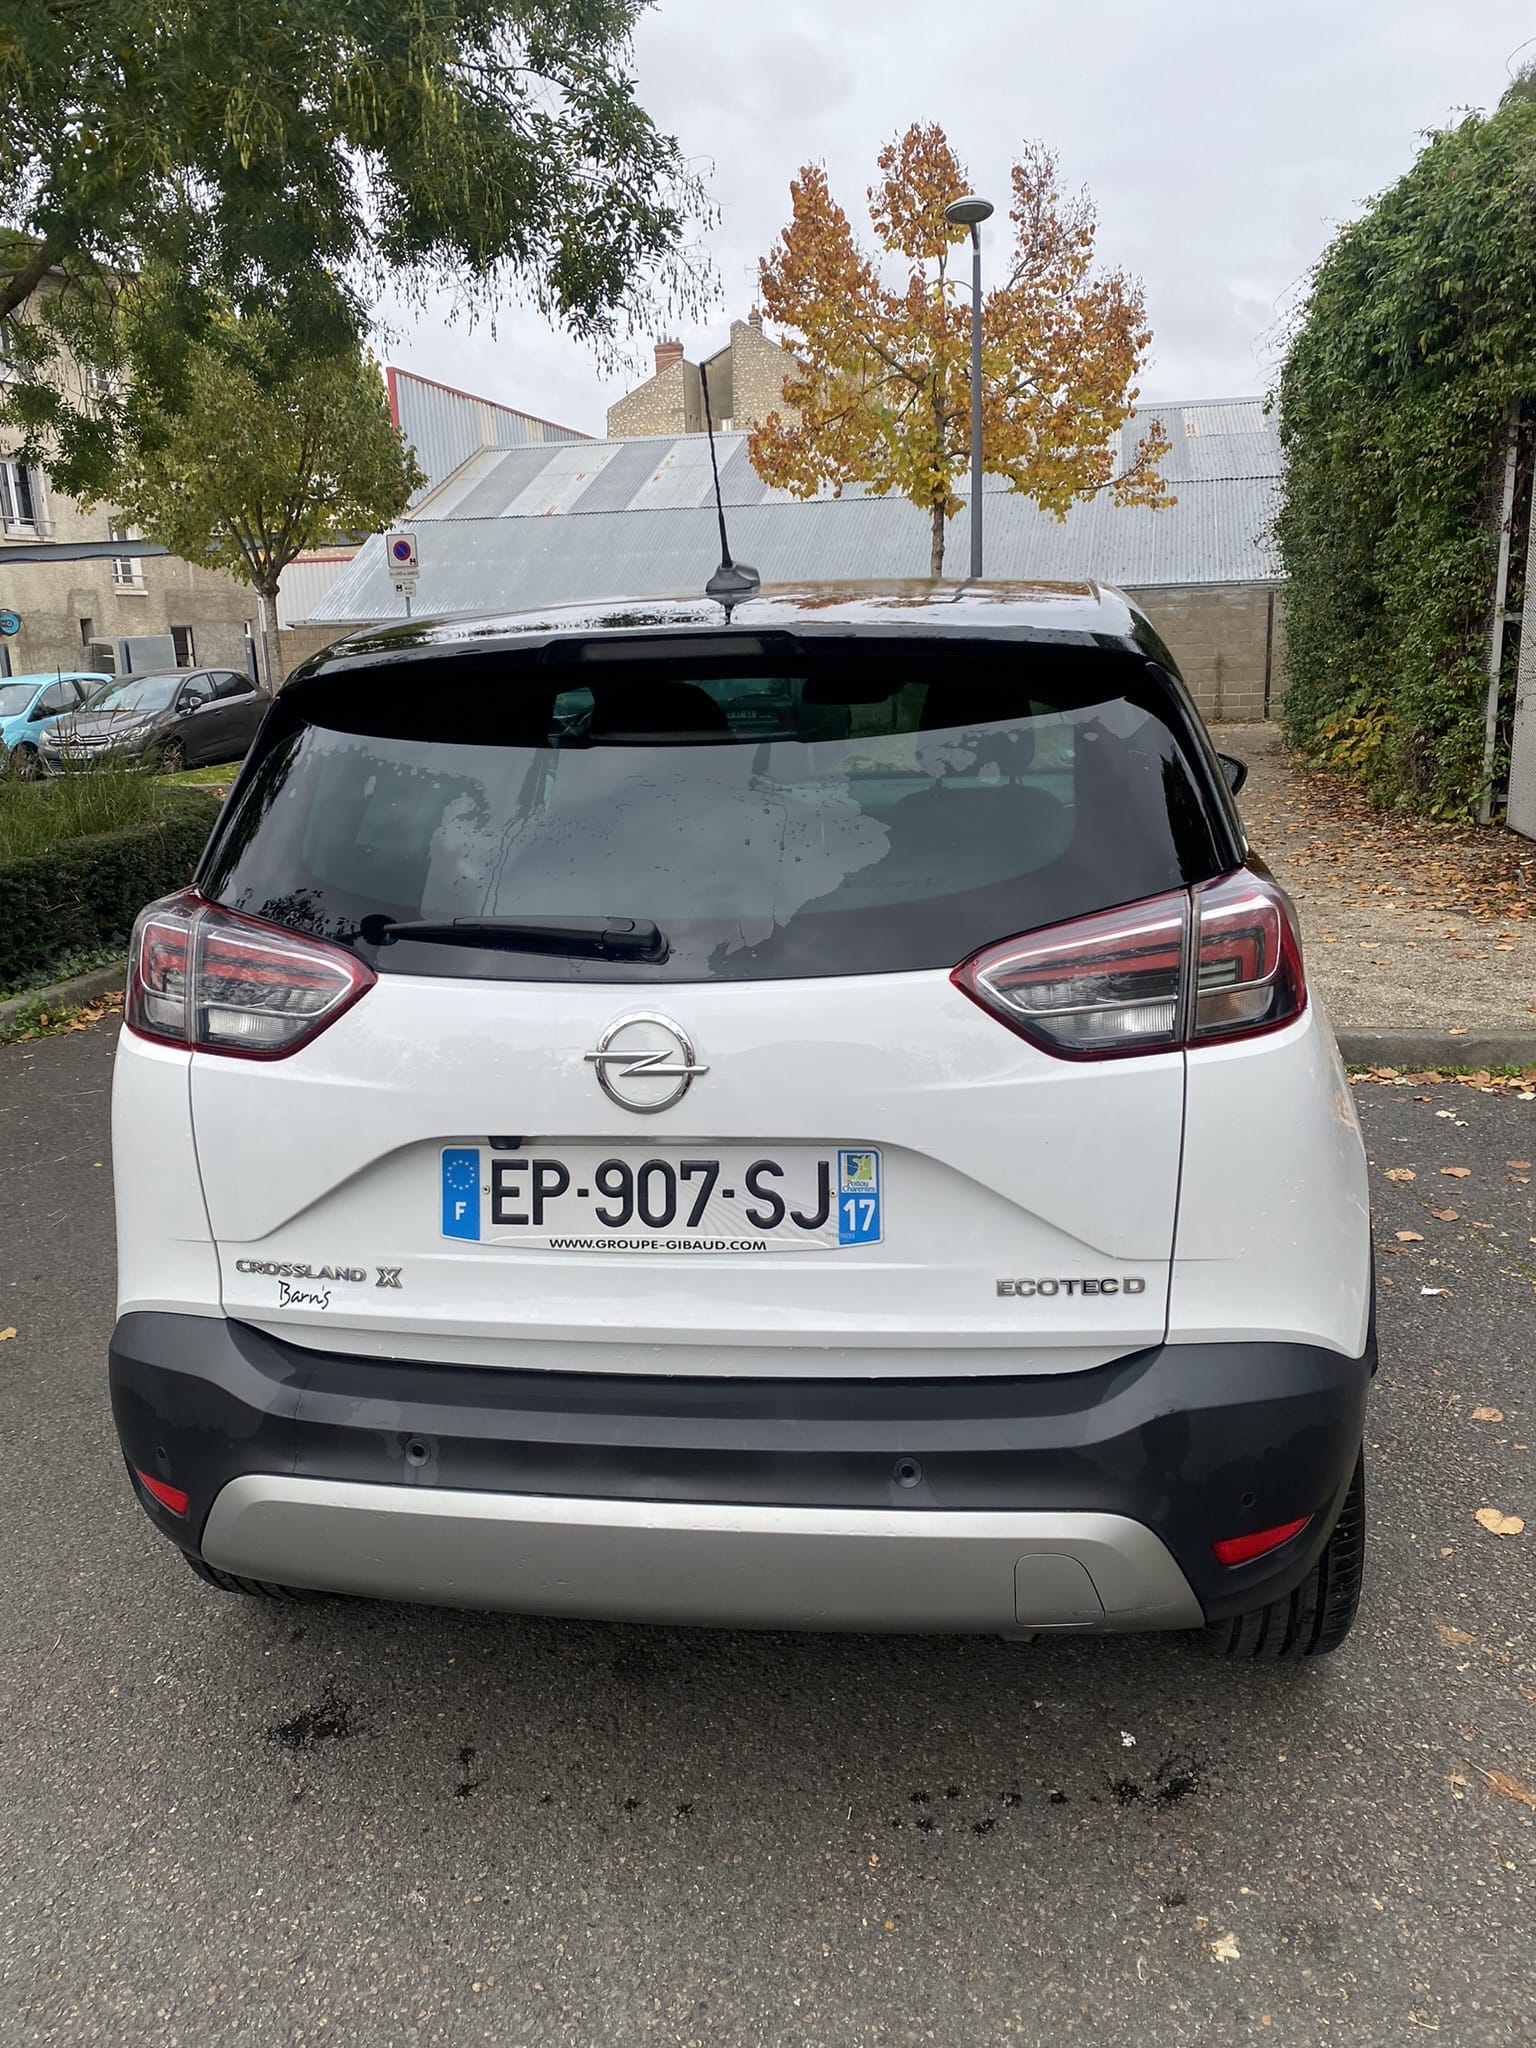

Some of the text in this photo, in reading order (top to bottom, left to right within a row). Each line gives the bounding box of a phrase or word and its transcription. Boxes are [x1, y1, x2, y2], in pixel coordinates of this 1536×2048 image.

[491, 1158, 829, 1230] EP-907-SJ
[455, 1202, 467, 1220] F
[843, 1199, 876, 1231] 17
[549, 1239, 767, 1251] WWW.GROUPE-GIBAUD.COM
[235, 1259, 403, 1288] CROSSLAND X
[996, 1277, 1119, 1297] ECOTEC
[278, 1280, 332, 1310] Barn's
